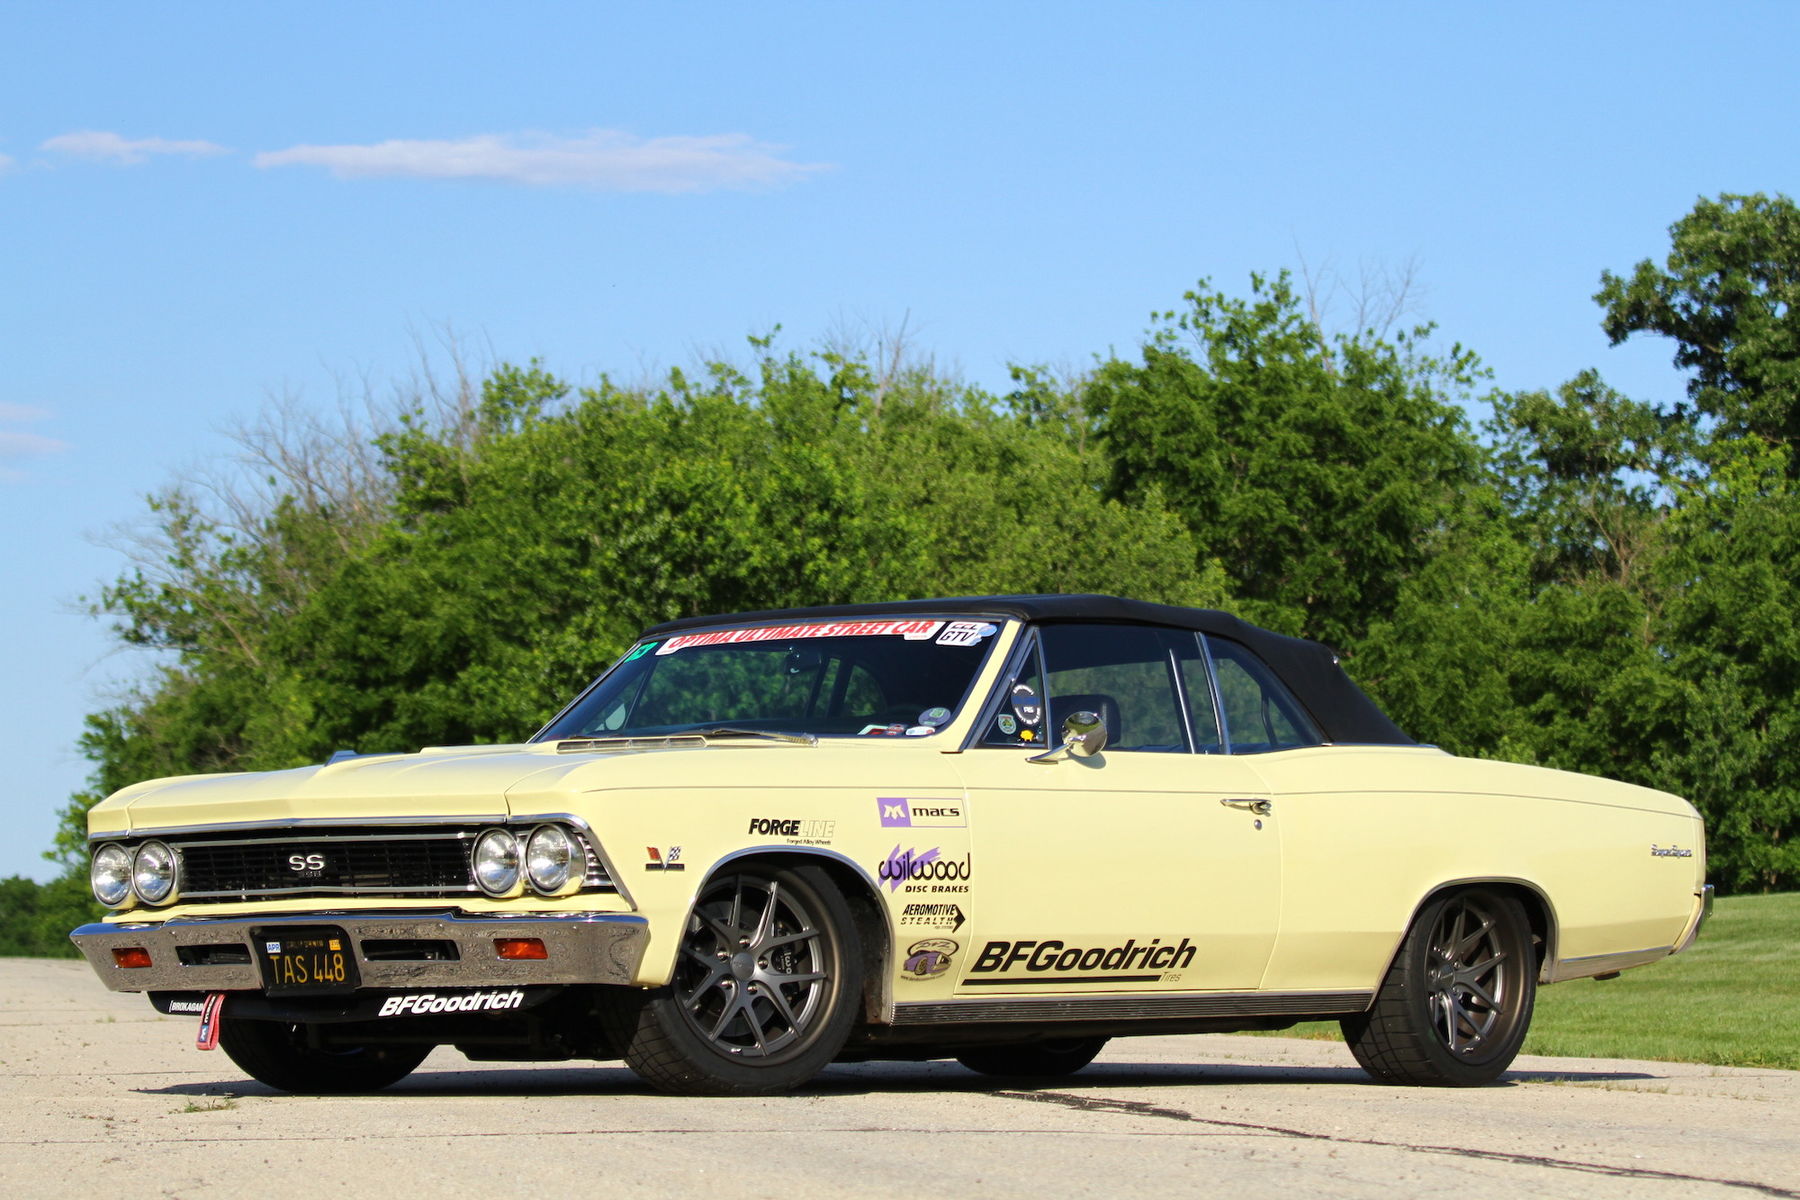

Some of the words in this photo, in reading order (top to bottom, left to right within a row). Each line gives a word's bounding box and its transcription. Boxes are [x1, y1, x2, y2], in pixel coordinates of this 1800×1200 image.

[668, 630, 733, 649] OPTIMA
[734, 624, 823, 642] ULTIMATE
[825, 621, 893, 636] STREET
[890, 620, 935, 634] CAR
[939, 630, 975, 642] GTV
[912, 807, 960, 816] macs
[748, 818, 836, 838] FORGELINE
[288, 854, 325, 871] SS
[878, 851, 971, 881] wilwood
[904, 885, 928, 893] DISC
[931, 885, 969, 893] BRAKES
[902, 903, 956, 916] AEROMOTIVE
[900, 916, 954, 925] STEALTH
[970, 938, 1197, 972] BFGoodrich
[269, 954, 308, 985] TAS
[313, 952, 345, 982] 448
[378, 988, 525, 1017] BFGoodrich
